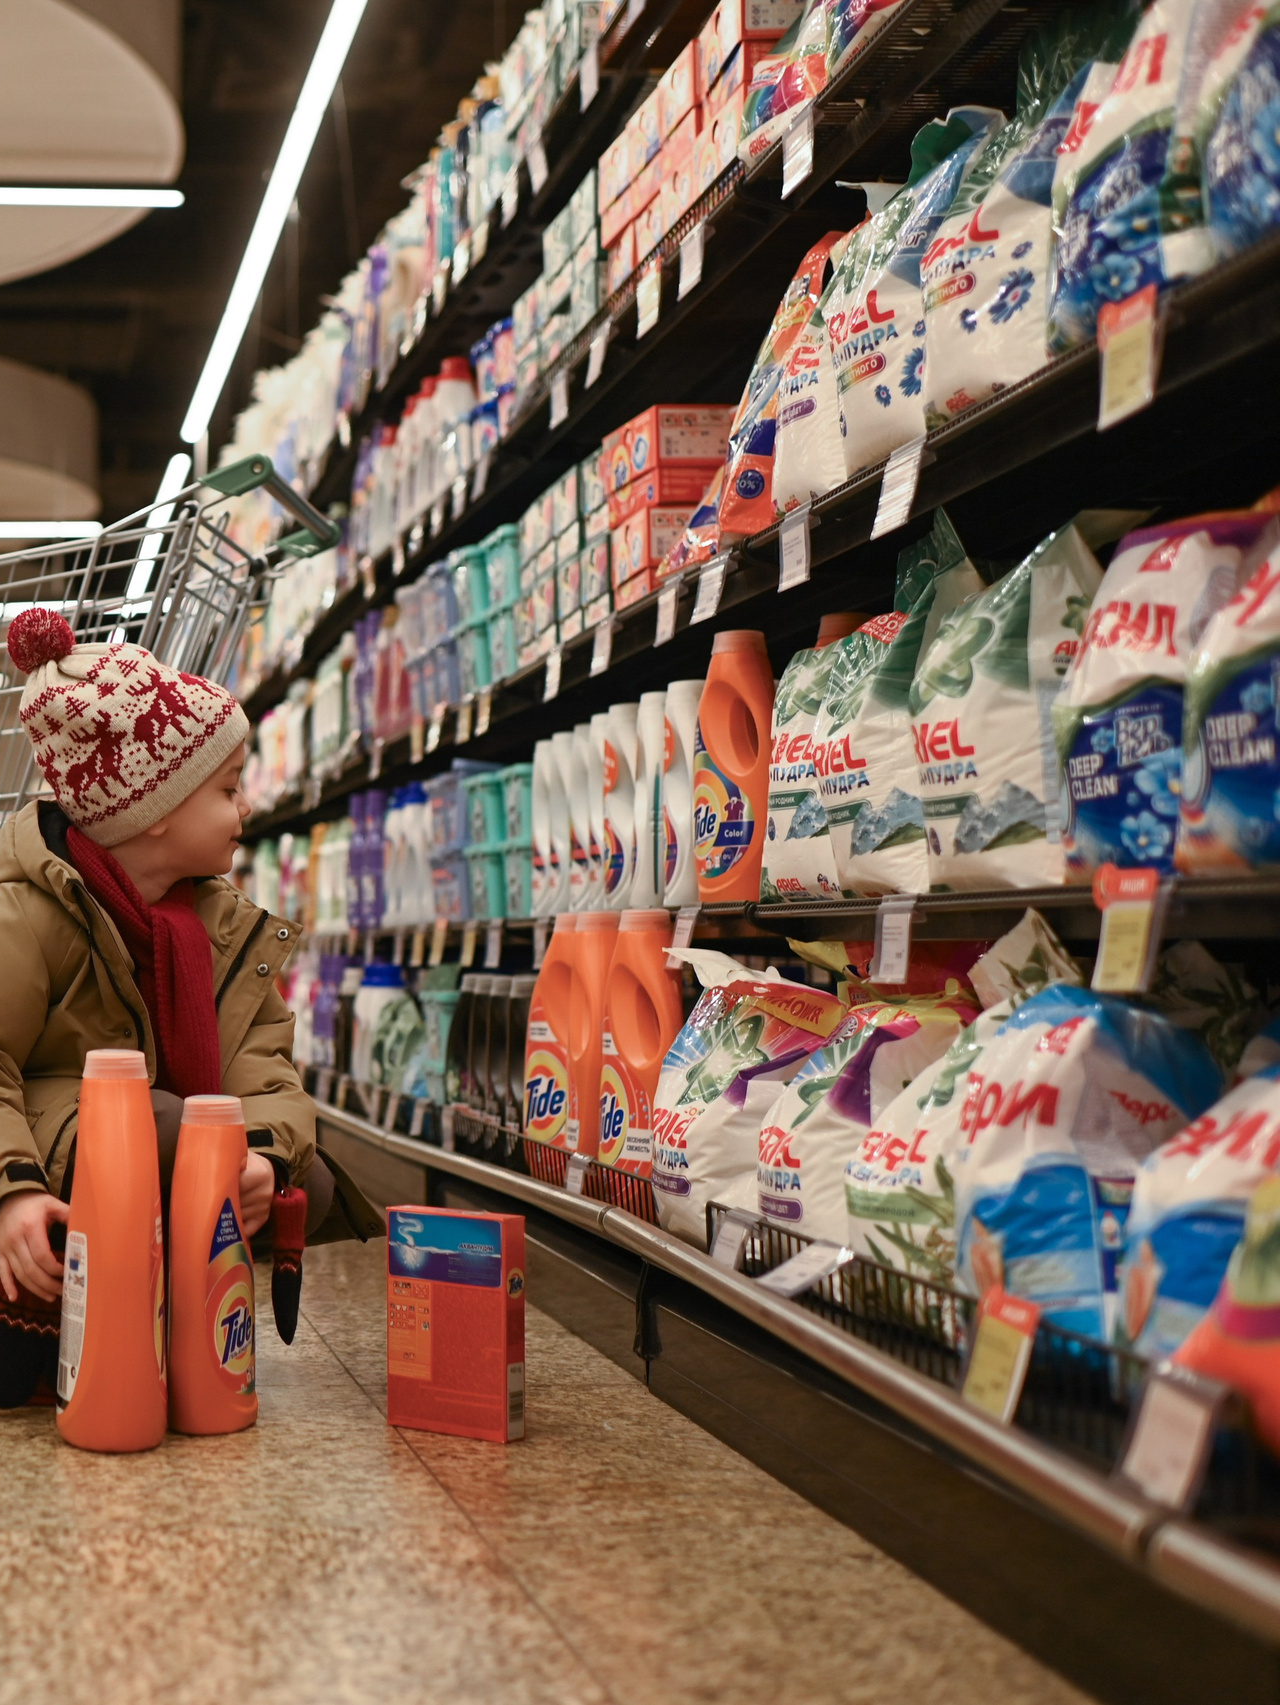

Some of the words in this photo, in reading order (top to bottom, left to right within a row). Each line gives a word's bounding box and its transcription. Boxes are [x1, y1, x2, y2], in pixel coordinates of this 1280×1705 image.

[1208, 738, 1276, 767] CLEAN
[1070, 754, 1104, 778] DEEP
[1071, 774, 1119, 800] CLEAN
[724, 829, 744, 838] Color
[776, 878, 806, 892] ARIEL
[526, 1077, 566, 1129] Tide
[626, 1145, 650, 1154] СВЕЖЕСТЬ
[220, 1227, 234, 1235] СТИРКА
[221, 1219, 233, 1227] ЦВЕТА
[221, 1307, 252, 1366] Tide
